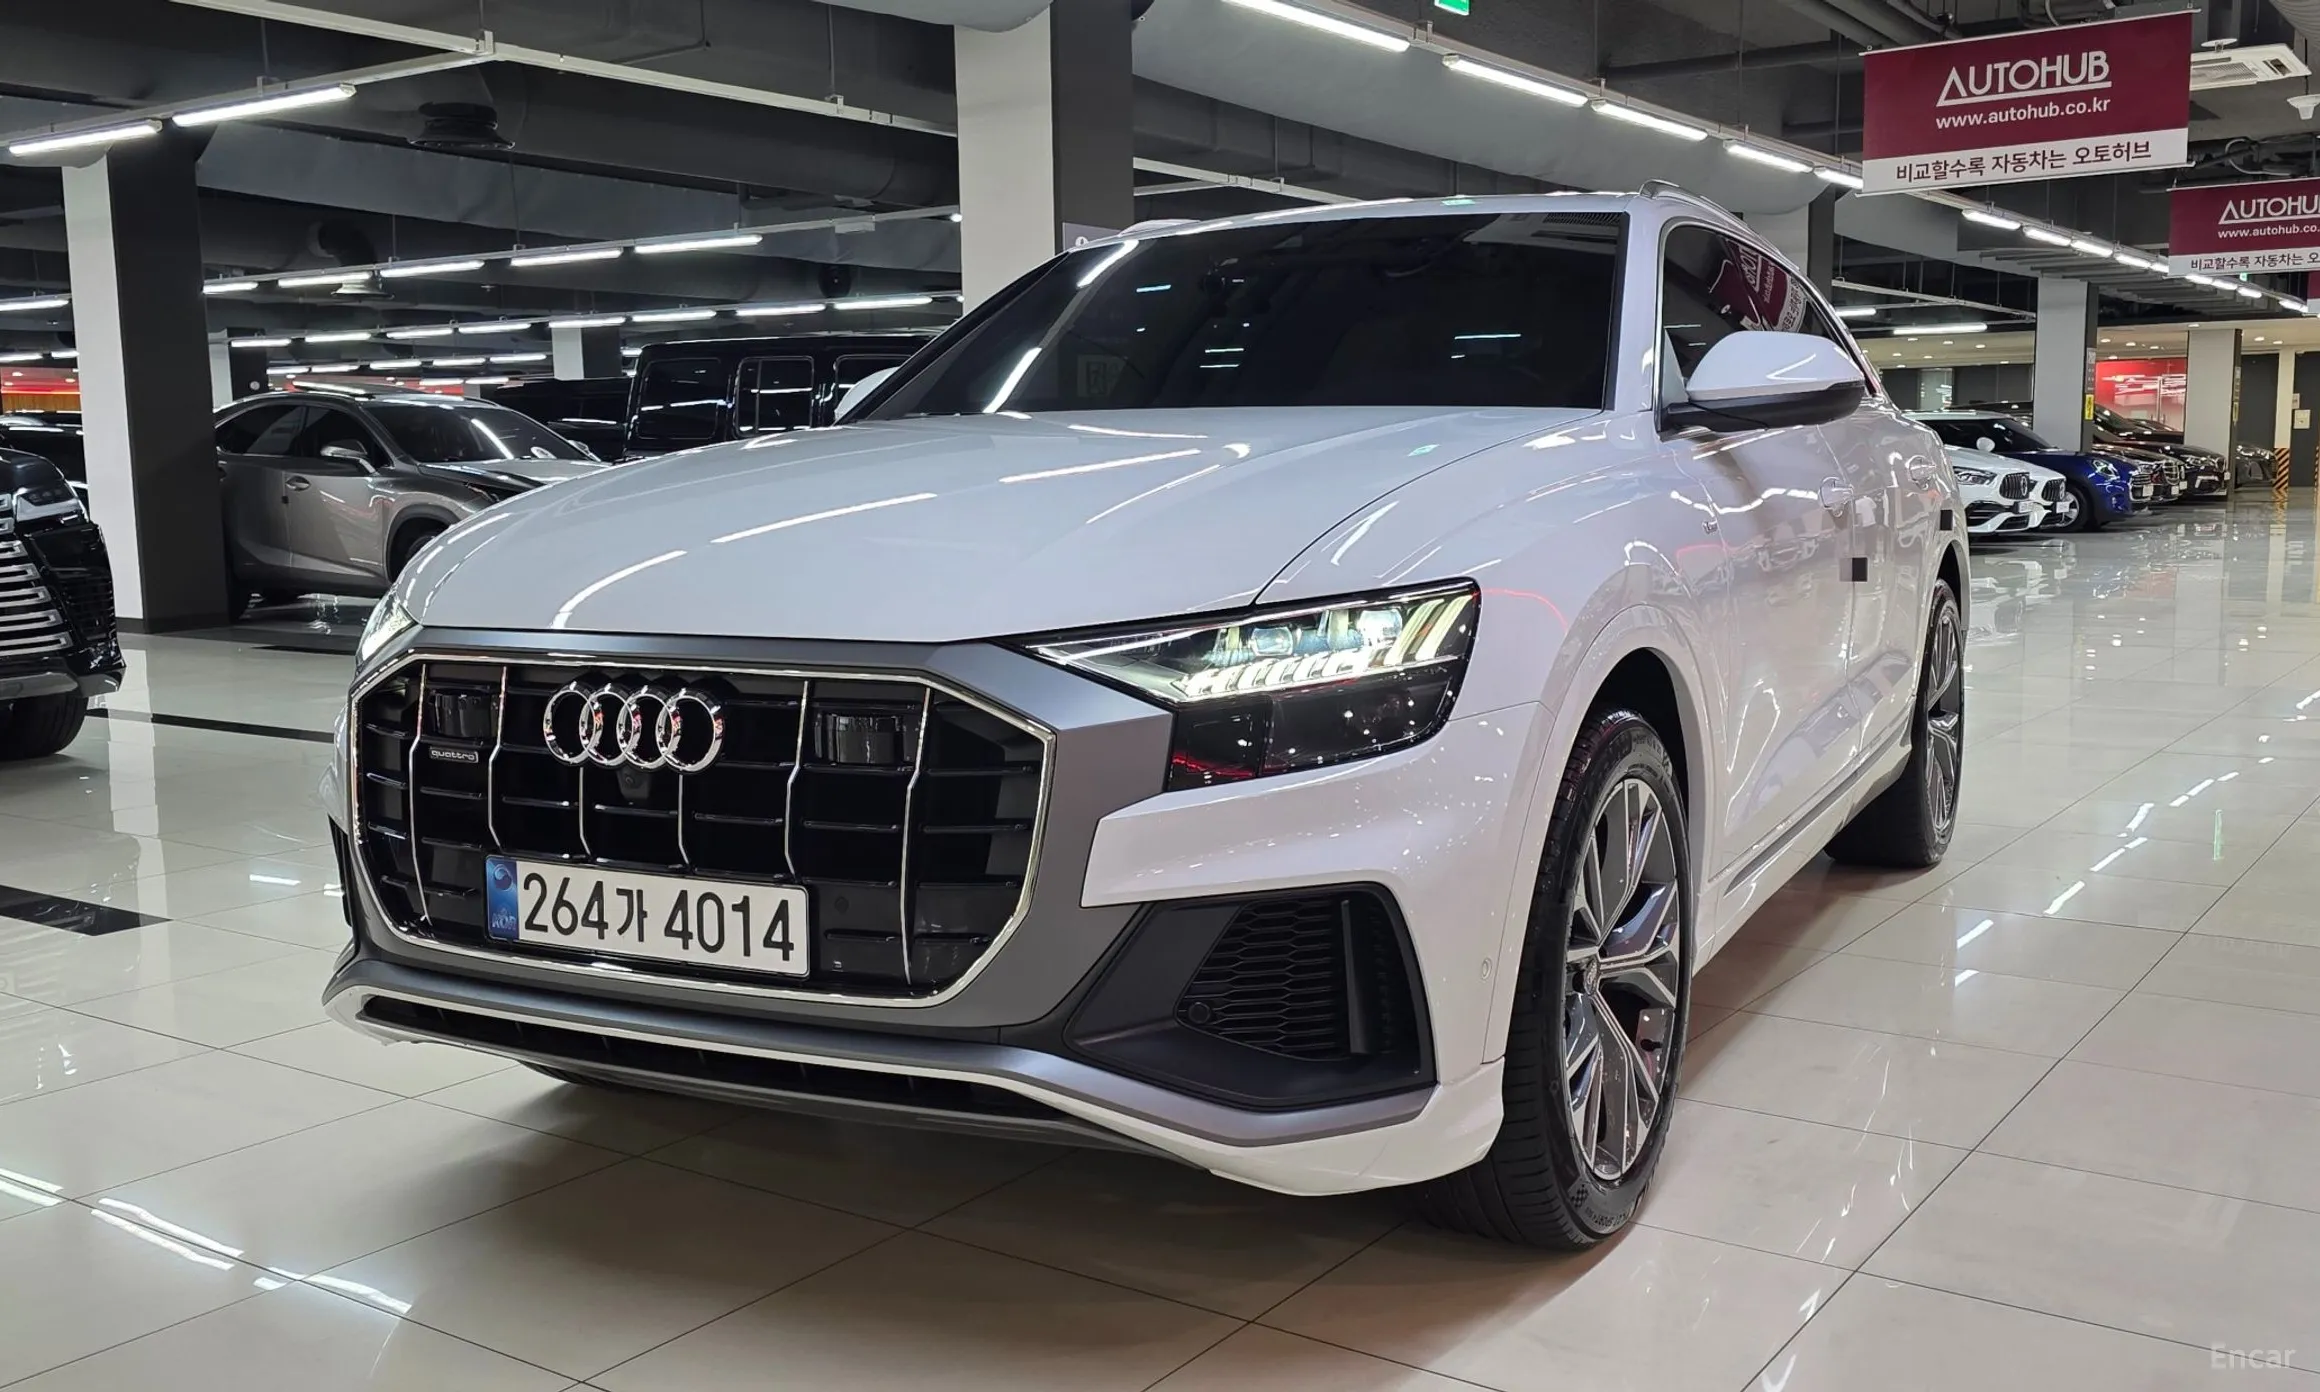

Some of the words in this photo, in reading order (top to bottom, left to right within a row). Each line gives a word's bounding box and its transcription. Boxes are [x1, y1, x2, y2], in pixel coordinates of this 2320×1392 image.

[1936, 50, 2112, 107] AUTOHUB
[1936, 97, 2111, 129] www.autohub.co.kr
[1896, 156, 1986, 183] 비교할수록
[1991, 149, 2067, 174] 자동차는
[2072, 140, 2152, 166] 오토허브
[2218, 194, 2320, 225] AUTOHU
[2191, 256, 2250, 271] 비교할수록
[2254, 253, 2303, 268] 자동차는
[431, 750, 475, 761] quattro
[523, 872, 648, 943] 264가
[664, 888, 794, 962] 4014
